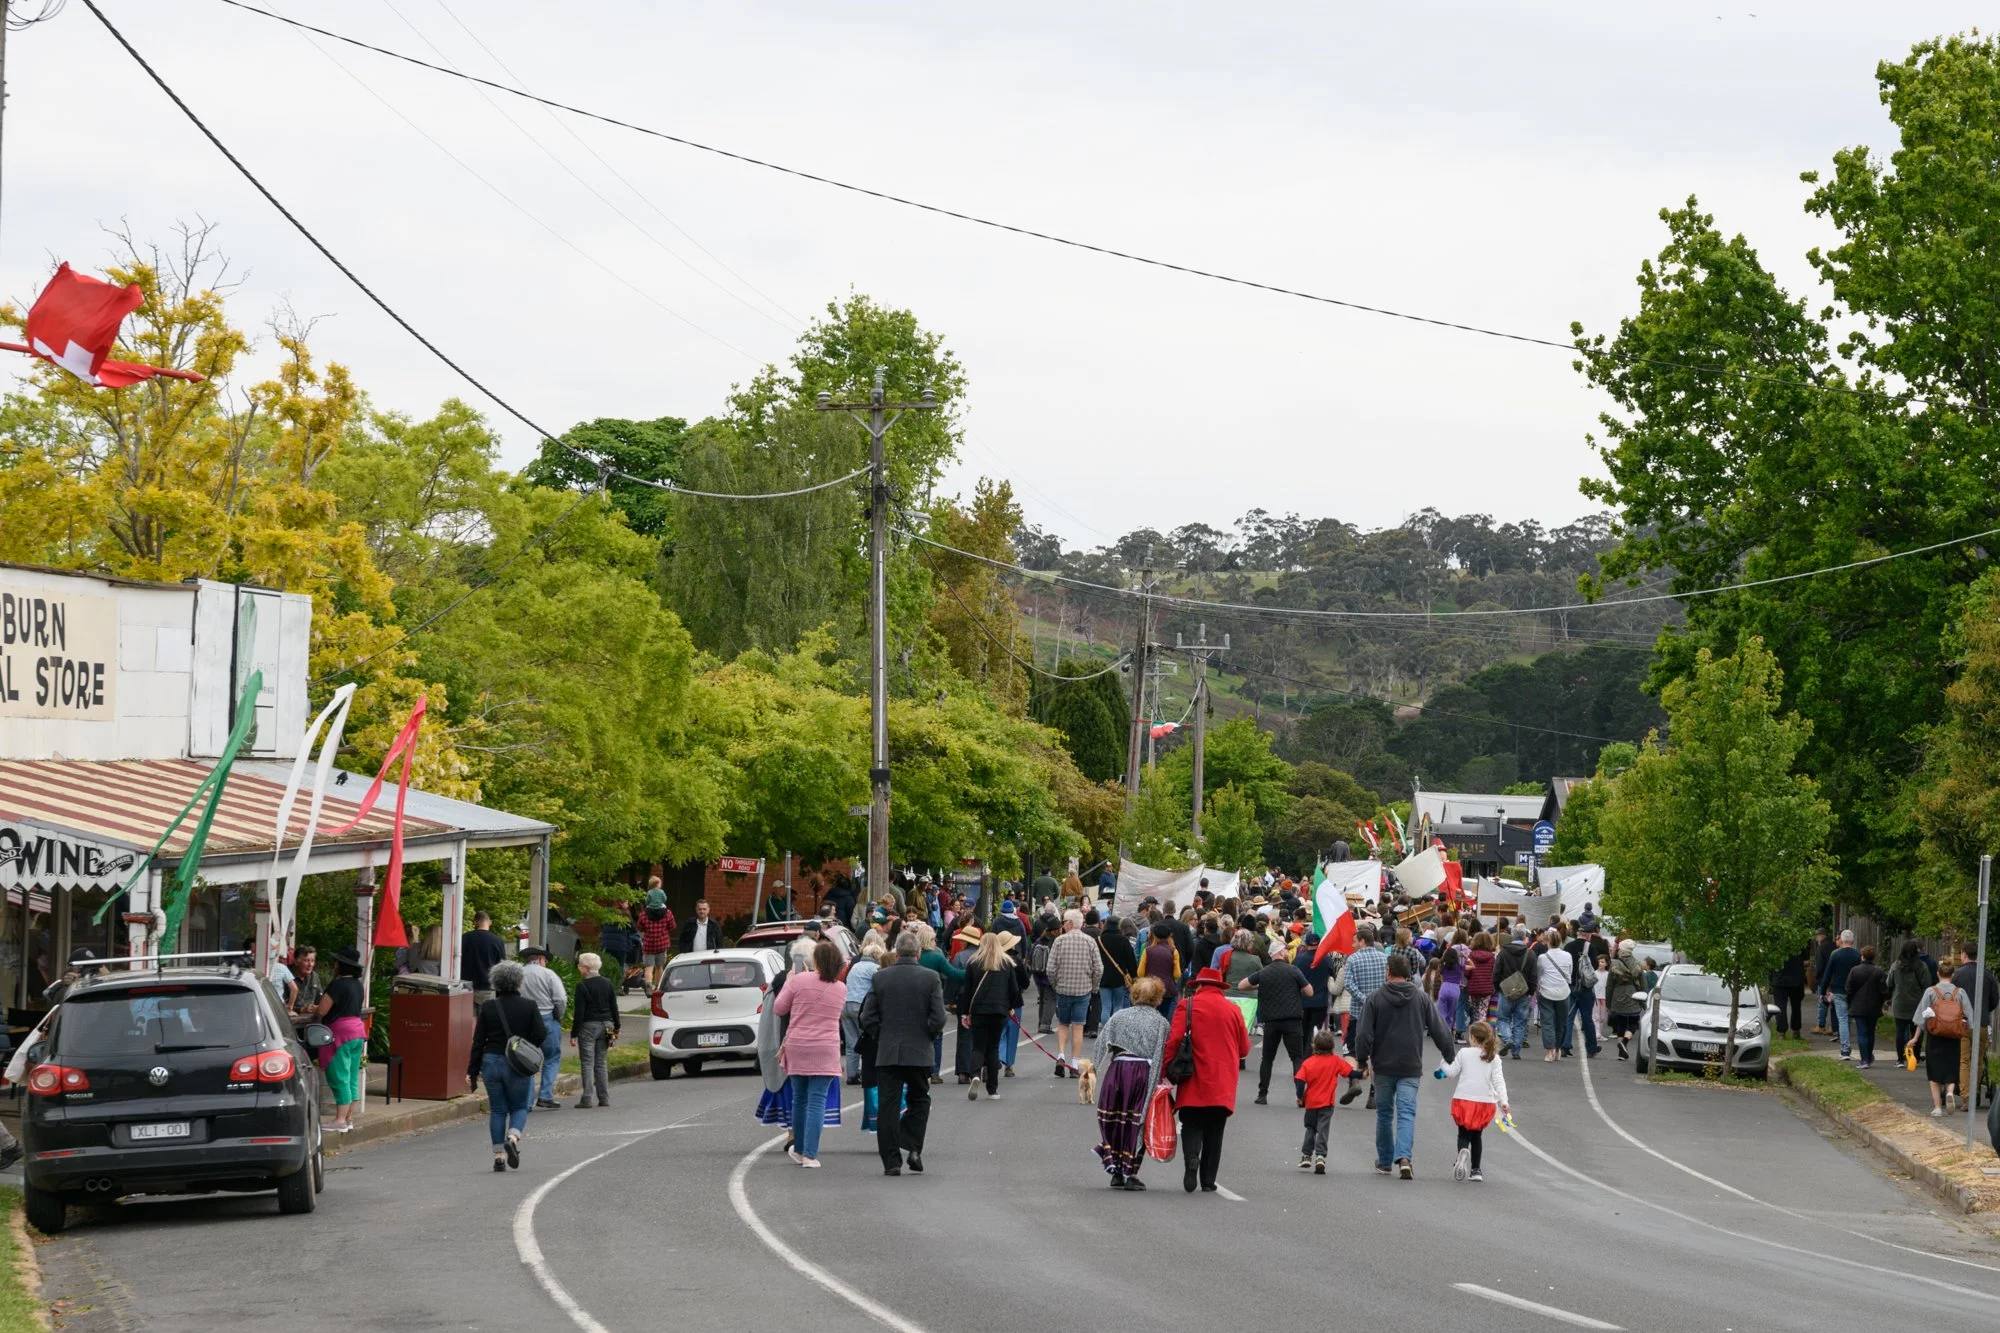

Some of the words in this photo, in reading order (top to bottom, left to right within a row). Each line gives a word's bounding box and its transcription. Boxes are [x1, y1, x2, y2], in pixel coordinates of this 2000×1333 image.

[36, 656, 104, 709] STORE
[16, 835, 104, 877] WINE
[721, 858, 734, 869] NO
